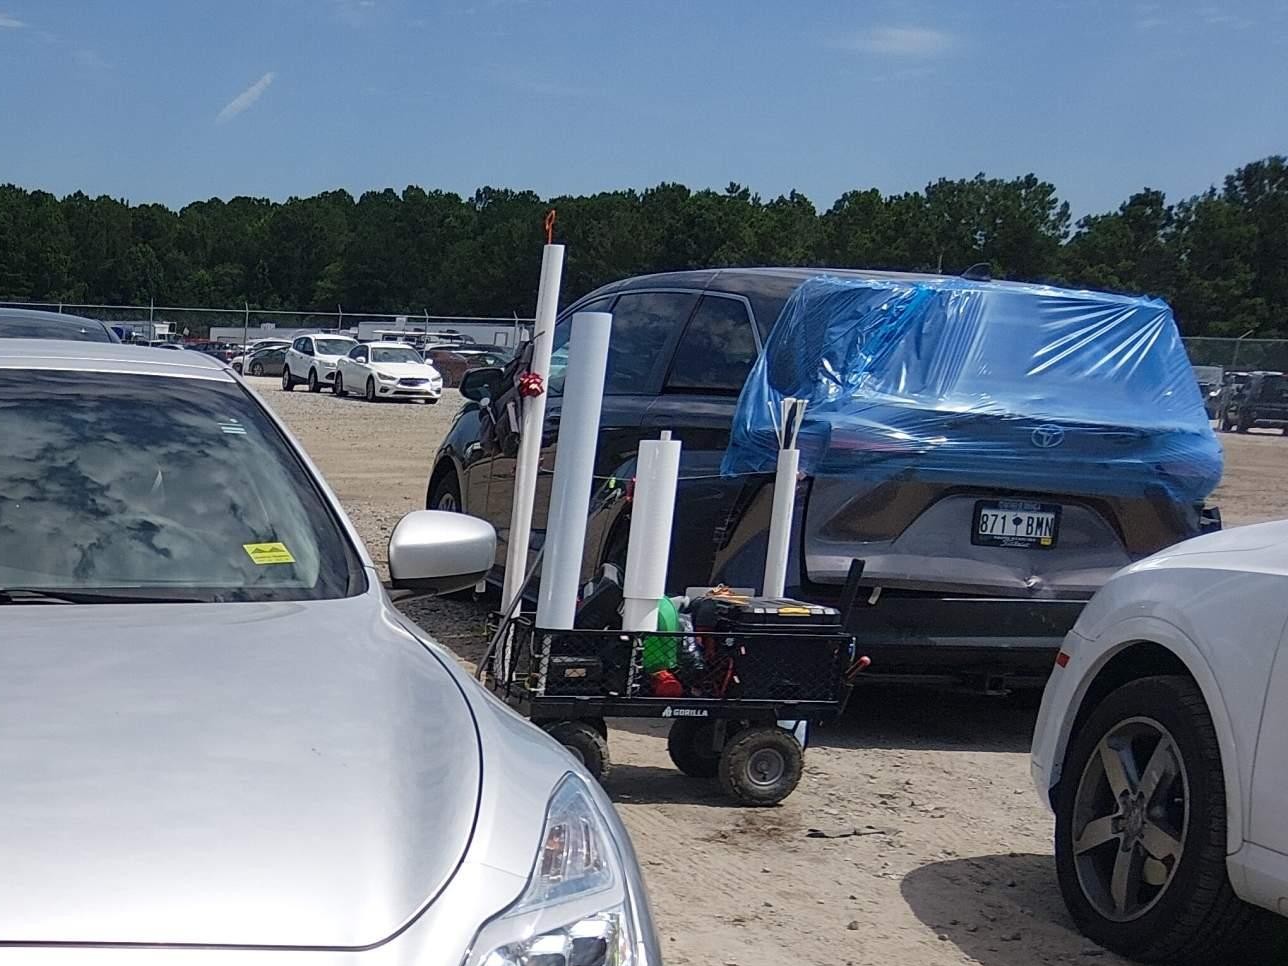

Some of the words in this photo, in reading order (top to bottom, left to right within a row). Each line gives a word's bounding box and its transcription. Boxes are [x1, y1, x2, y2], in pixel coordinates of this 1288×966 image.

[980, 513, 1007, 534] 871
[1025, 516, 1054, 536] BMN
[673, 709, 708, 717] GORILLA
